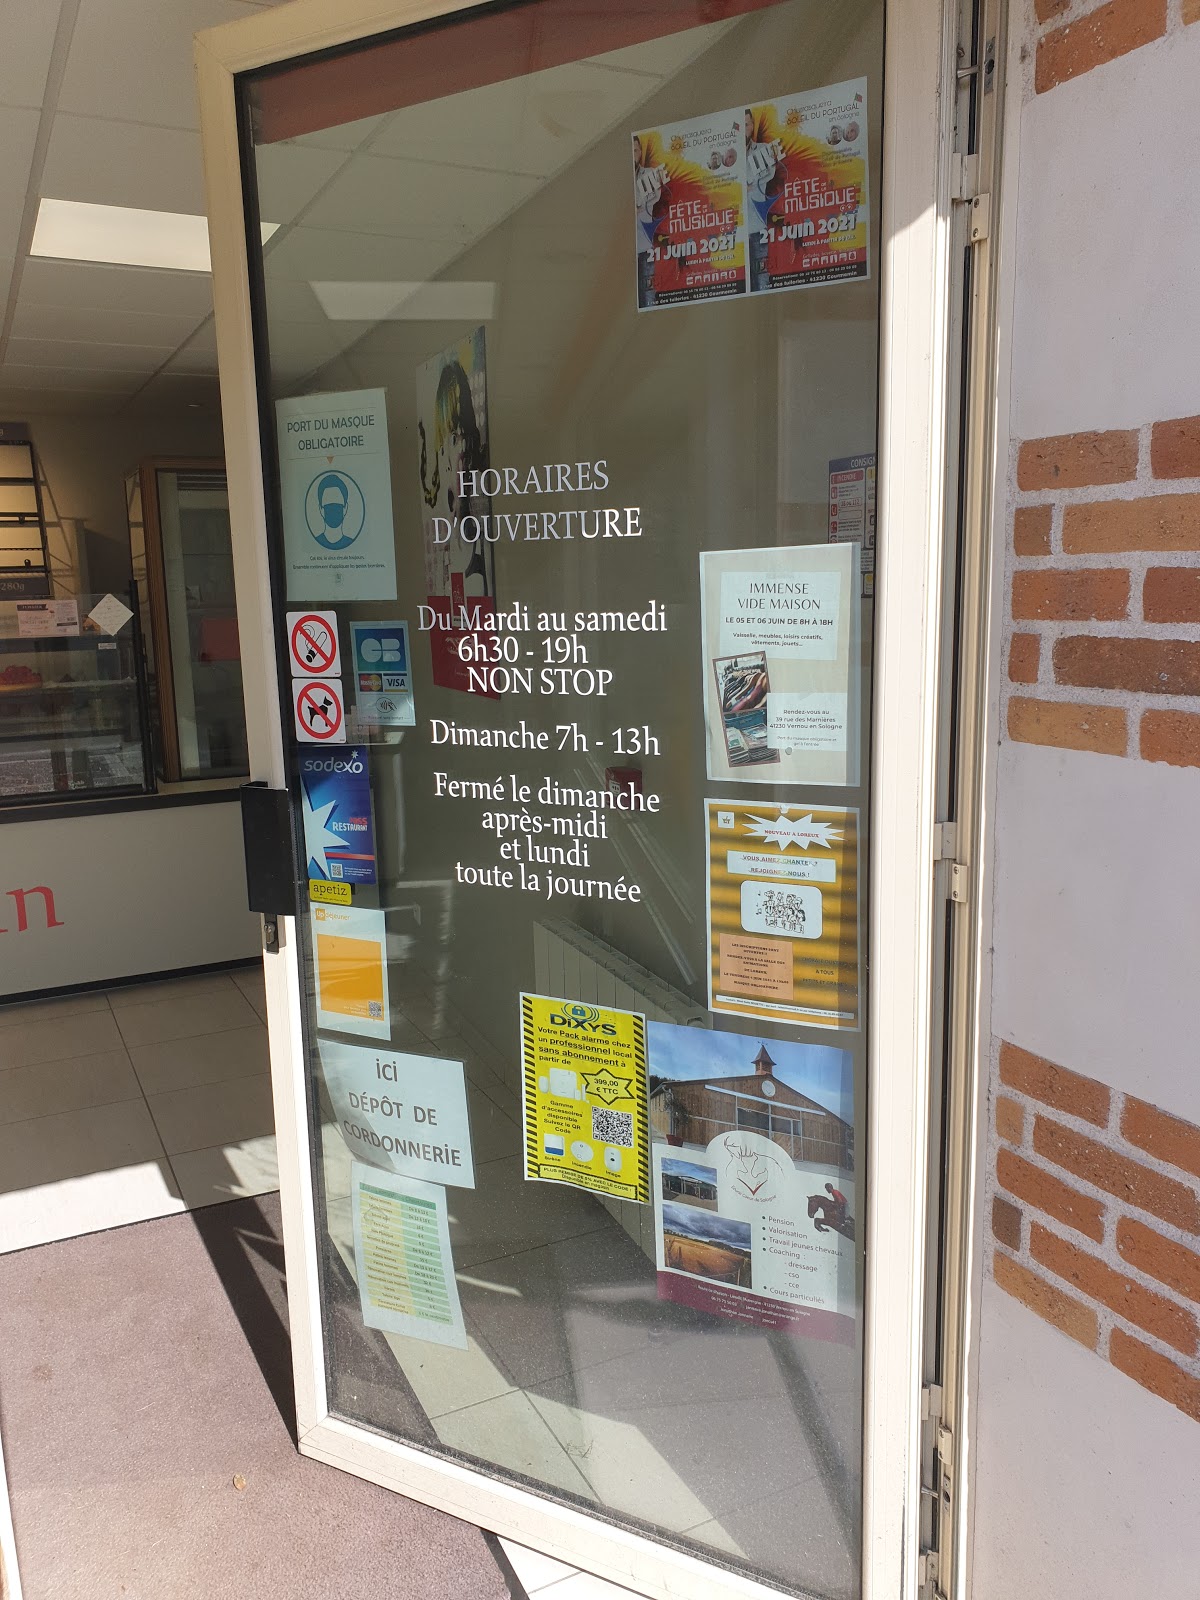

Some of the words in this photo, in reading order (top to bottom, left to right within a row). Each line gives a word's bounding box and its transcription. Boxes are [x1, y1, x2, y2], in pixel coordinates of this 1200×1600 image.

[822, 102, 860, 117] PORTUGAL
[704, 130, 737, 144] PORTUGAL
[784, 177, 820, 198] FÊTE
[670, 200, 700, 218] FÊTE
[784, 187, 855, 214] MUSIQUE
[670, 210, 734, 234] MUSIQUE
[760, 227, 775, 244] 21
[818, 214, 856, 234] 2021
[646, 247, 660, 262] 21
[700, 234, 736, 254] 2021
[288, 420, 312, 432] PORT
[314, 419, 330, 431] DU
[332, 415, 374, 430] MASQUE
[298, 435, 364, 450] OBLIGATOIRE
[457, 460, 609, 498] HORAIRES
[432, 507, 642, 544] D'OUVERTURE
[0, 582, 25, 591] 280g
[750, 582, 810, 594] IMMENSE
[738, 598, 766, 610] VIDE
[770, 598, 821, 610] MAISON
[417, 604, 452, 631] Du
[458, 601, 530, 632] Mardi
[536, 610, 568, 631] au
[574, 600, 668, 632] samedi
[458, 634, 519, 663] 6h30
[540, 633, 589, 664] 19h
[386, 679, 405, 687] VISA
[467, 666, 534, 694] NON
[540, 668, 613, 696] STOP
[430, 719, 549, 750] Dimanche
[556, 723, 588, 752] 7h
[612, 726, 660, 756] 13h
[304, 757, 364, 774] sodexo
[434, 772, 504, 801] Fermé
[510, 775, 531, 802] le
[538, 776, 660, 812] dimanche
[482, 807, 608, 838] après-midi
[500, 840, 522, 860] et
[526, 834, 590, 868] lundi
[742, 854, 760, 862] VOUS
[313, 884, 347, 896] apetiz
[455, 862, 514, 888] toute
[518, 863, 540, 892] la
[546, 869, 642, 902] journée
[538, 1026, 558, 1034] Votre
[560, 1030, 580, 1040] Pack
[582, 1035, 610, 1045] alarme
[612, 1040, 631, 1048] chez
[538, 1046, 560, 1054] sans
[562, 1050, 619, 1067] abonnement
[550, 1038, 610, 1055] professionnel
[612, 1049, 632, 1058] local
[538, 1054, 559, 1063] partir
[594, 1077, 618, 1087] 399,00
[349, 1092, 403, 1119] DÉPÔT
[413, 1105, 438, 1126] DE
[542, 1105, 582, 1118] d'accessoires
[550, 1100, 574, 1109] Gamme
[544, 1118, 563, 1126] Suivez
[547, 1113, 578, 1123] disponible
[555, 1126, 571, 1134] Code
[768, 1216, 795, 1227] Pension
[769, 1226, 808, 1239] Valorisation
[769, 1236, 790, 1247] Travail
[791, 1241, 814, 1252] jeunes
[815, 1245, 843, 1256] chevaux
[769, 1246, 800, 1260] Coaching
[788, 1260, 818, 1273] dressage
[788, 1271, 800, 1279] cso
[770, 1287, 789, 1297] Cours
